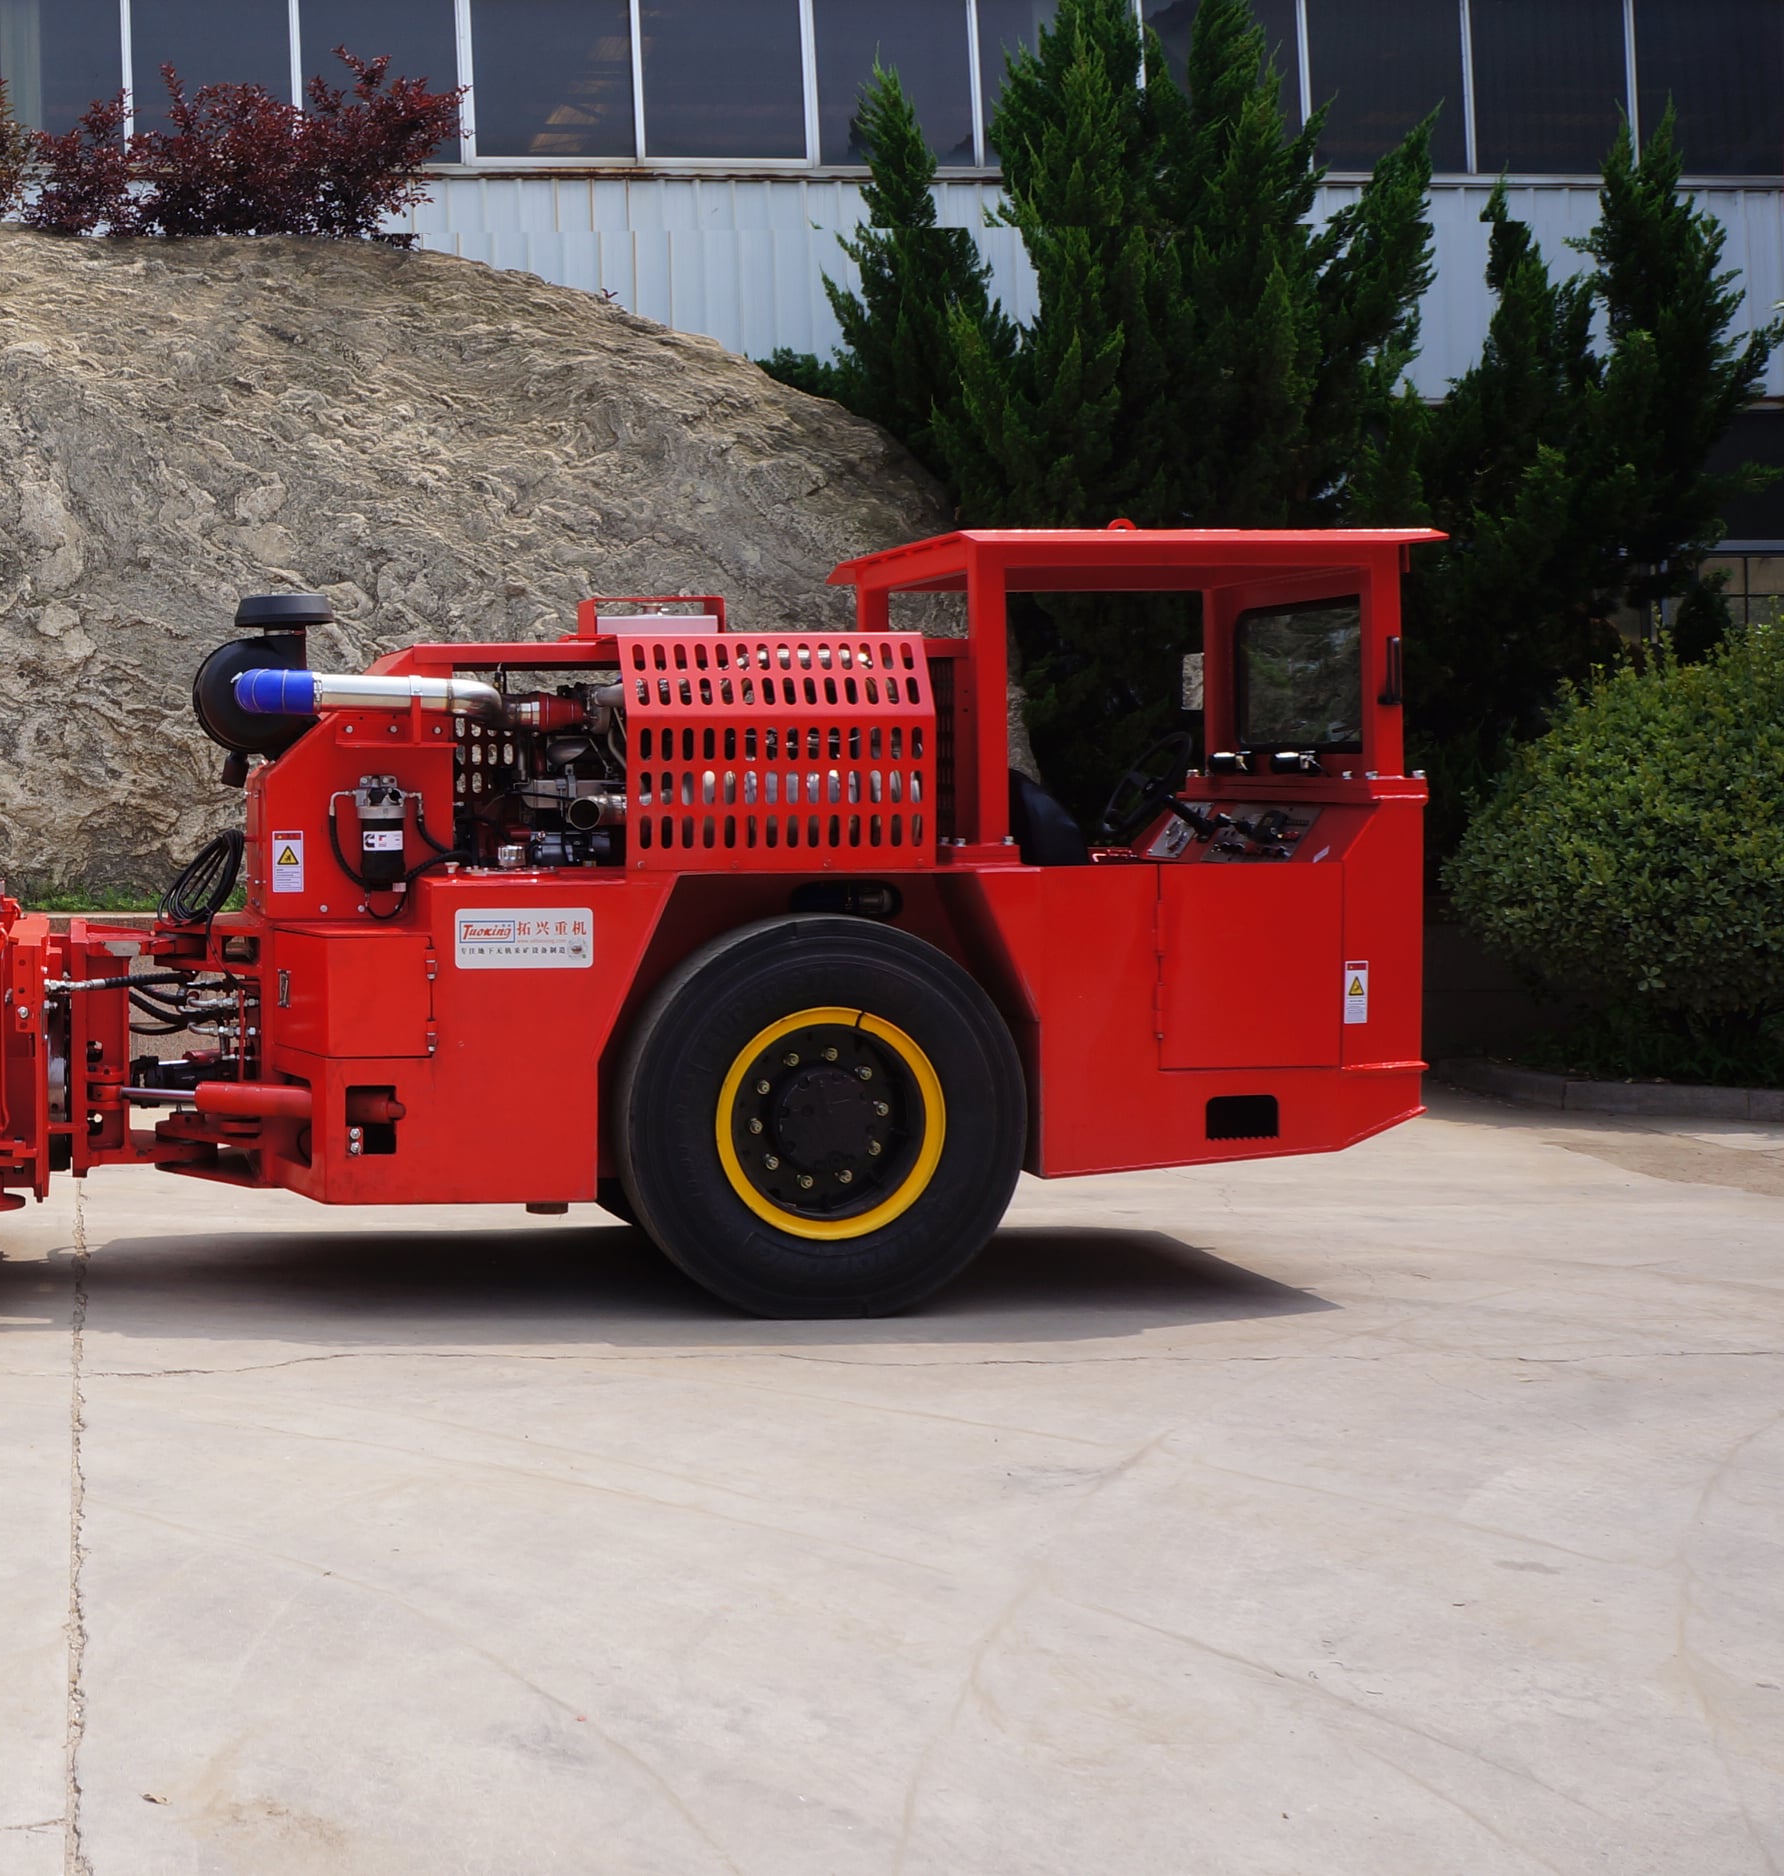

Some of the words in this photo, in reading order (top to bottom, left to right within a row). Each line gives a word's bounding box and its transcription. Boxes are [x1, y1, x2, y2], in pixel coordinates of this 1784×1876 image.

[463, 924, 512, 940] Tuoxing
[517, 920, 587, 936] 拓兴重机
